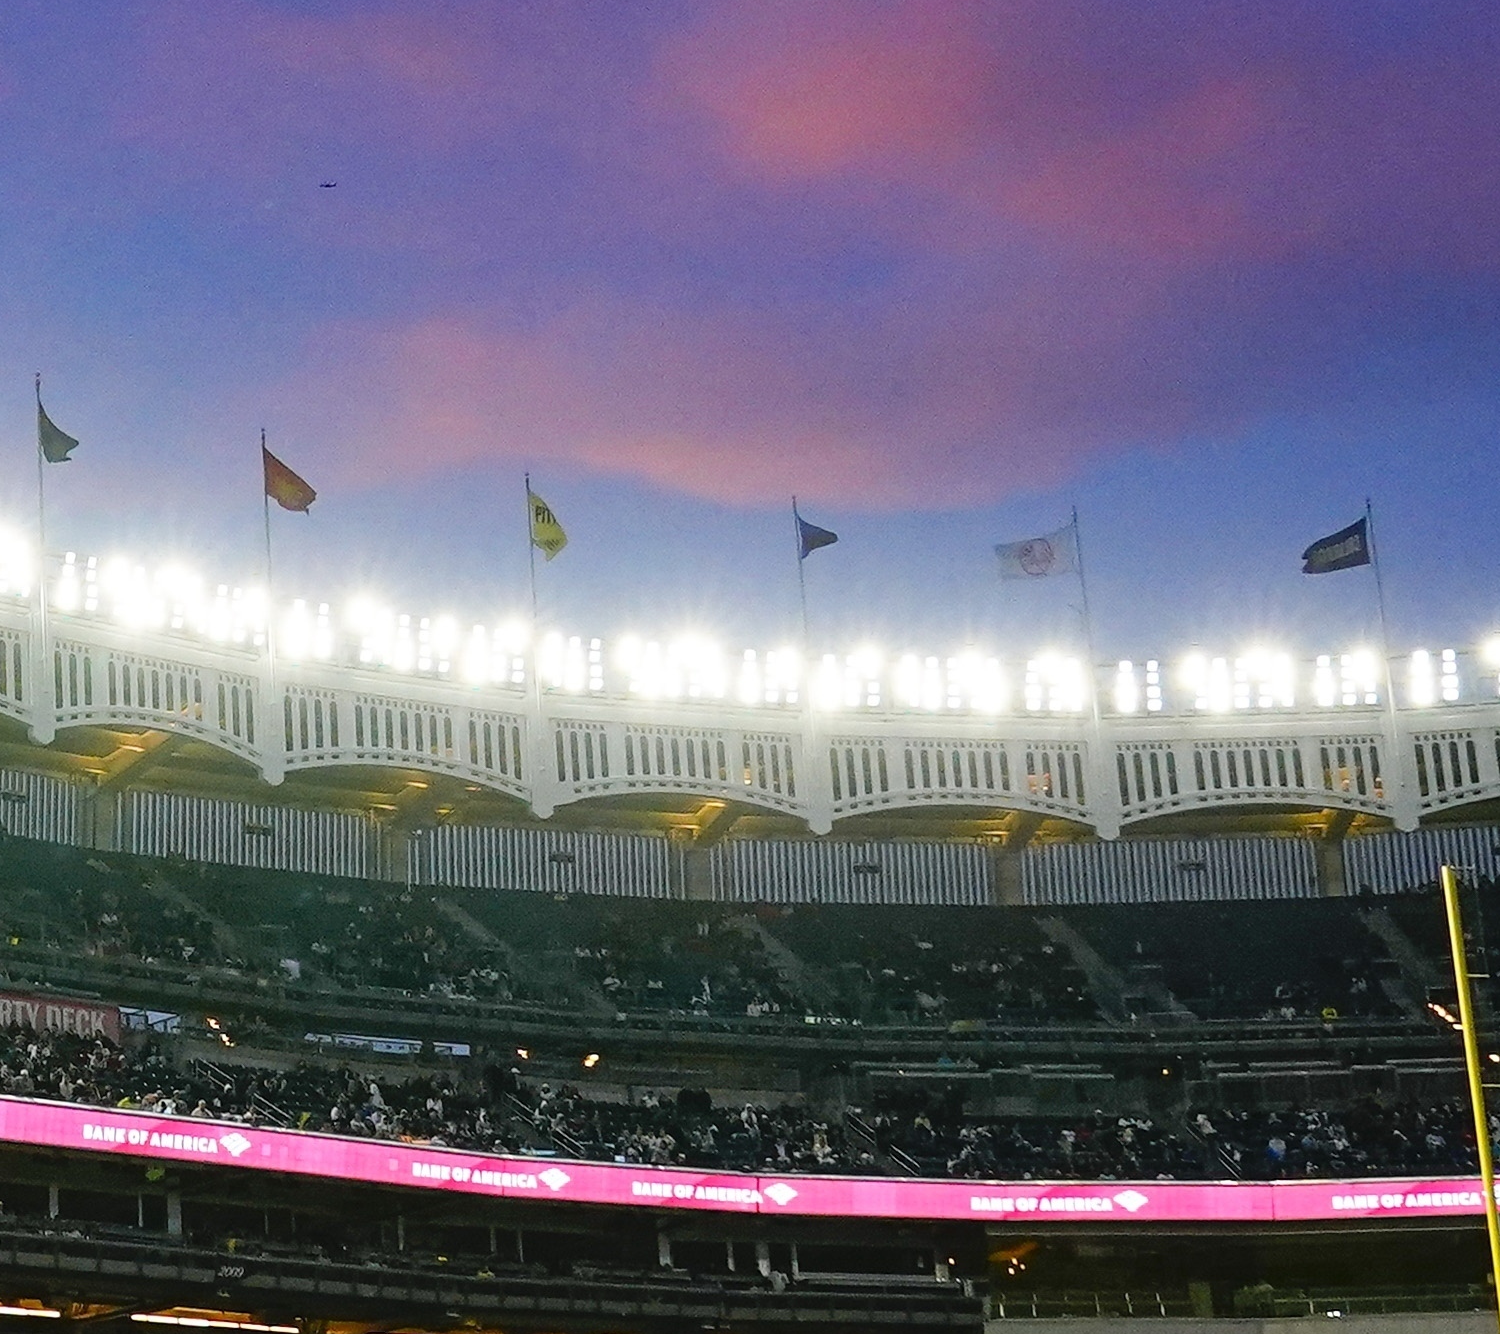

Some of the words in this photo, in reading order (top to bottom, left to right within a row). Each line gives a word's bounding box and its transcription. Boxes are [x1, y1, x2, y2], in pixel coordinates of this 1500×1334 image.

[45, 1008, 107, 1036] DECK
[82, 1124, 126, 1144] BANK
[128, 1129, 149, 1146] OF
[150, 1132, 218, 1154] AMERICA
[411, 1162, 451, 1180] BANK
[452, 1166, 471, 1183] OF
[471, 1169, 537, 1189] AMERICA
[631, 1181, 673, 1198] BANK
[673, 1184, 694, 1200] OF
[695, 1186, 763, 1204] AMERICA
[970, 1196, 1014, 1211] BANK
[1015, 1196, 1038, 1211] OF
[1039, 1197, 1113, 1212] AMERICA
[1331, 1194, 1380, 1210] BANK
[1380, 1193, 1404, 1209] OF
[1405, 1192, 1482, 1208] AMERICA
